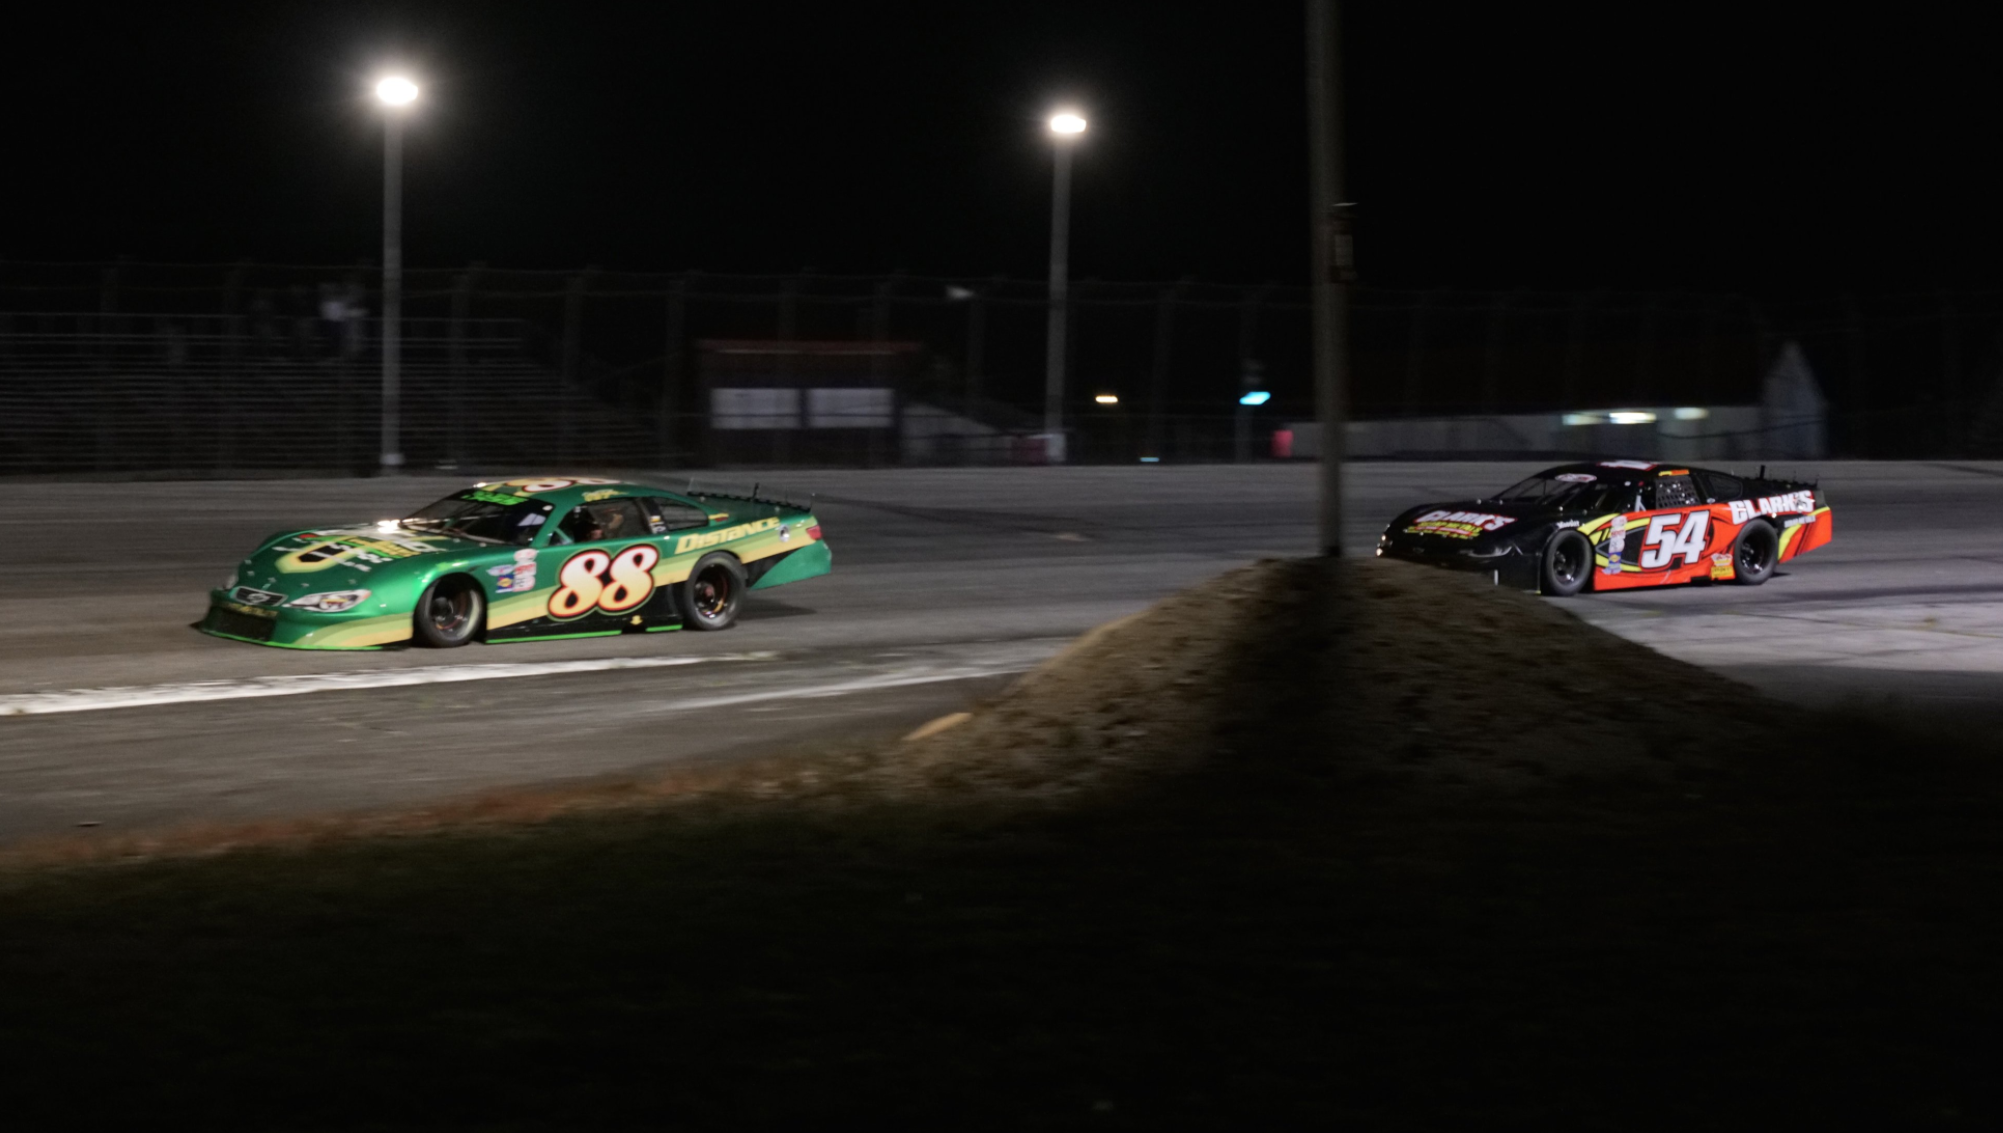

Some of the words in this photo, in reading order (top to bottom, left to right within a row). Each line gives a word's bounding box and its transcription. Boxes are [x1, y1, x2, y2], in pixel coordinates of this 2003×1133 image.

[1728, 490, 1815, 525] CLARK'S
[1641, 511, 1709, 569] 54
[548, 544, 659, 618] 88
